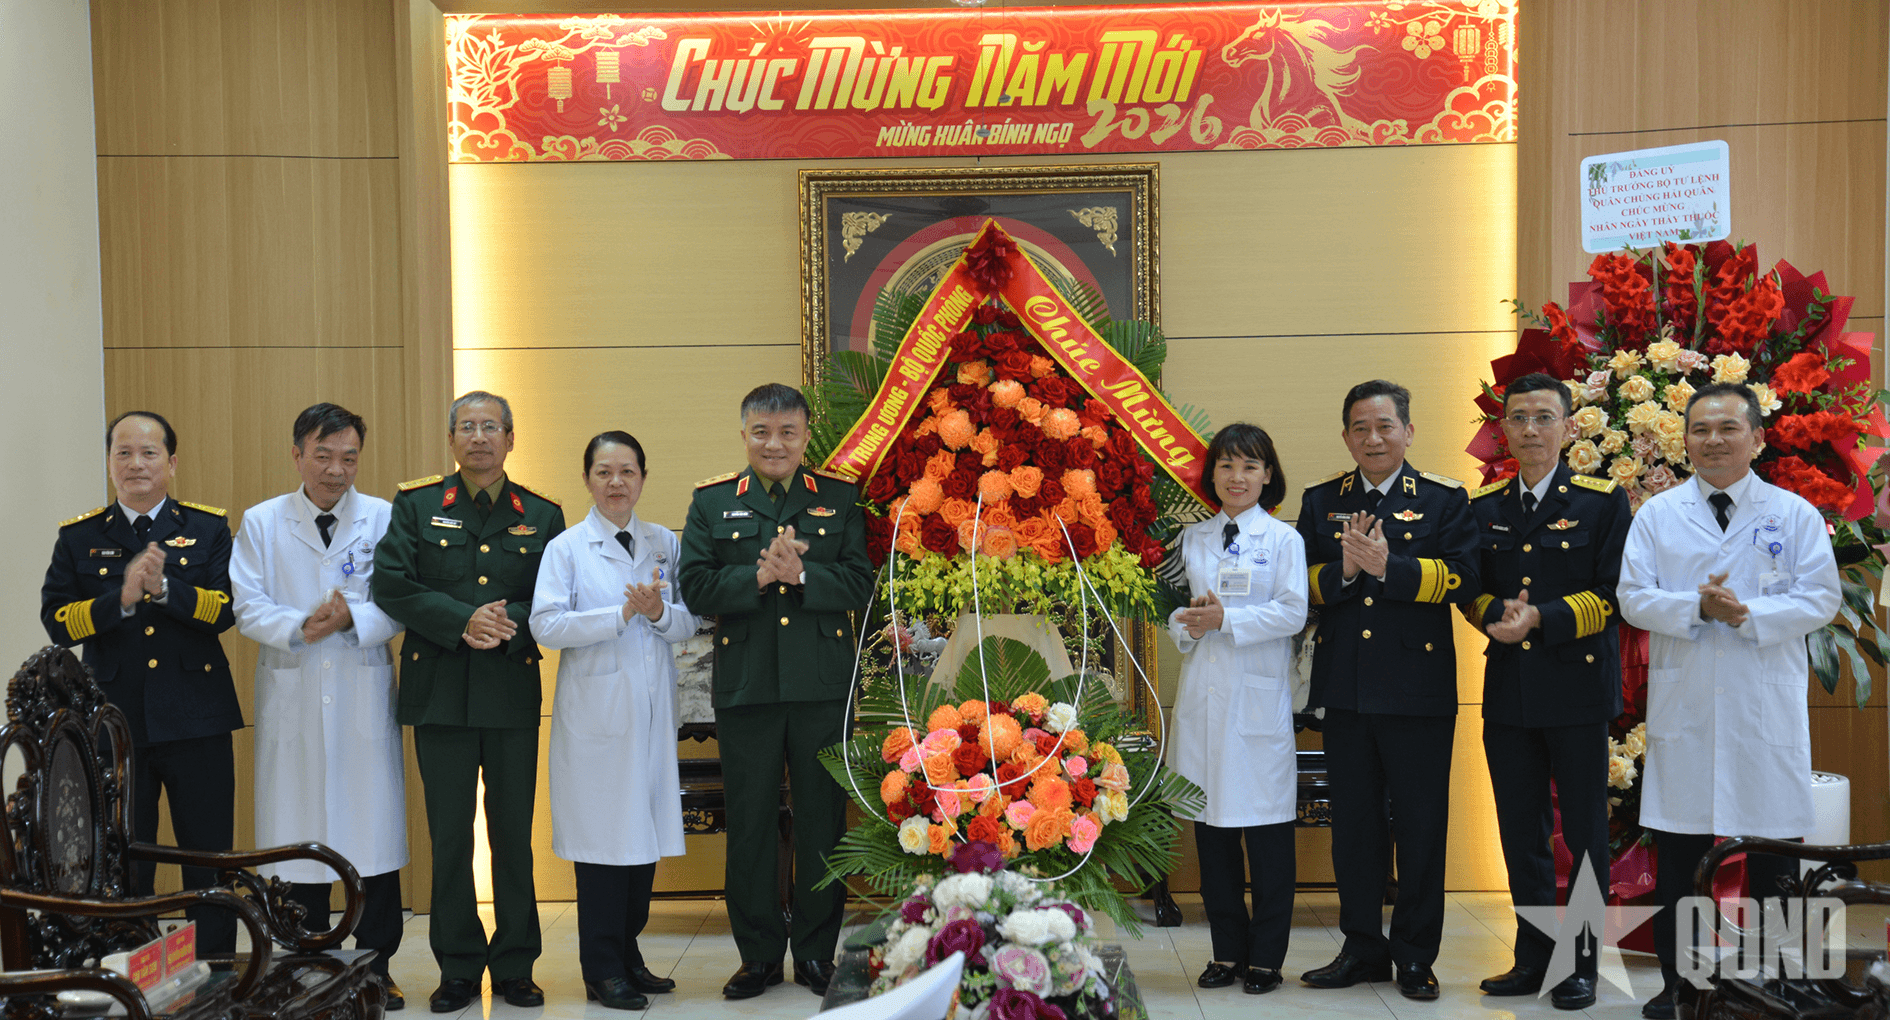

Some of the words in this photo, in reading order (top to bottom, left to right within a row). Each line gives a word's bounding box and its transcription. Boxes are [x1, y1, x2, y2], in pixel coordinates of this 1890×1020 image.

[795, 36, 955, 112] MỪNG
[965, 33, 1090, 107] NĂM
[1088, 30, 1203, 104] MỚI
[876, 119, 932, 147] MỪNG
[932, 119, 988, 146] XUÂN
[987, 117, 1034, 145] BÍNH
[1032, 122, 1074, 148] NGỌ
[1080, 93, 1224, 149] 2026
[1592, 196, 1621, 210] QUÂN
[1684, 186, 1714, 198] QUÂN
[1657, 178, 1671, 188] BỘ
[1673, 175, 1689, 186] TƯ
[1691, 173, 1719, 185] LỆNH
[1589, 221, 1618, 232] NHÂN
[1620, 217, 1648, 229] NGÀY
[1621, 205, 1650, 217] CHÚC
[1629, 230, 1653, 241] VIỆT
[1655, 228, 1679, 238] NAM
[933, 284, 975, 333] PHÒNG
[911, 325, 947, 364] QUỐC
[899, 356, 929, 382] BỘ
[1025, 295, 1101, 376] Chúc
[1100, 377, 1196, 470] Mừng
[877, 385, 909, 427] ƯƠNG
[848, 422, 890, 467] TRUNG
